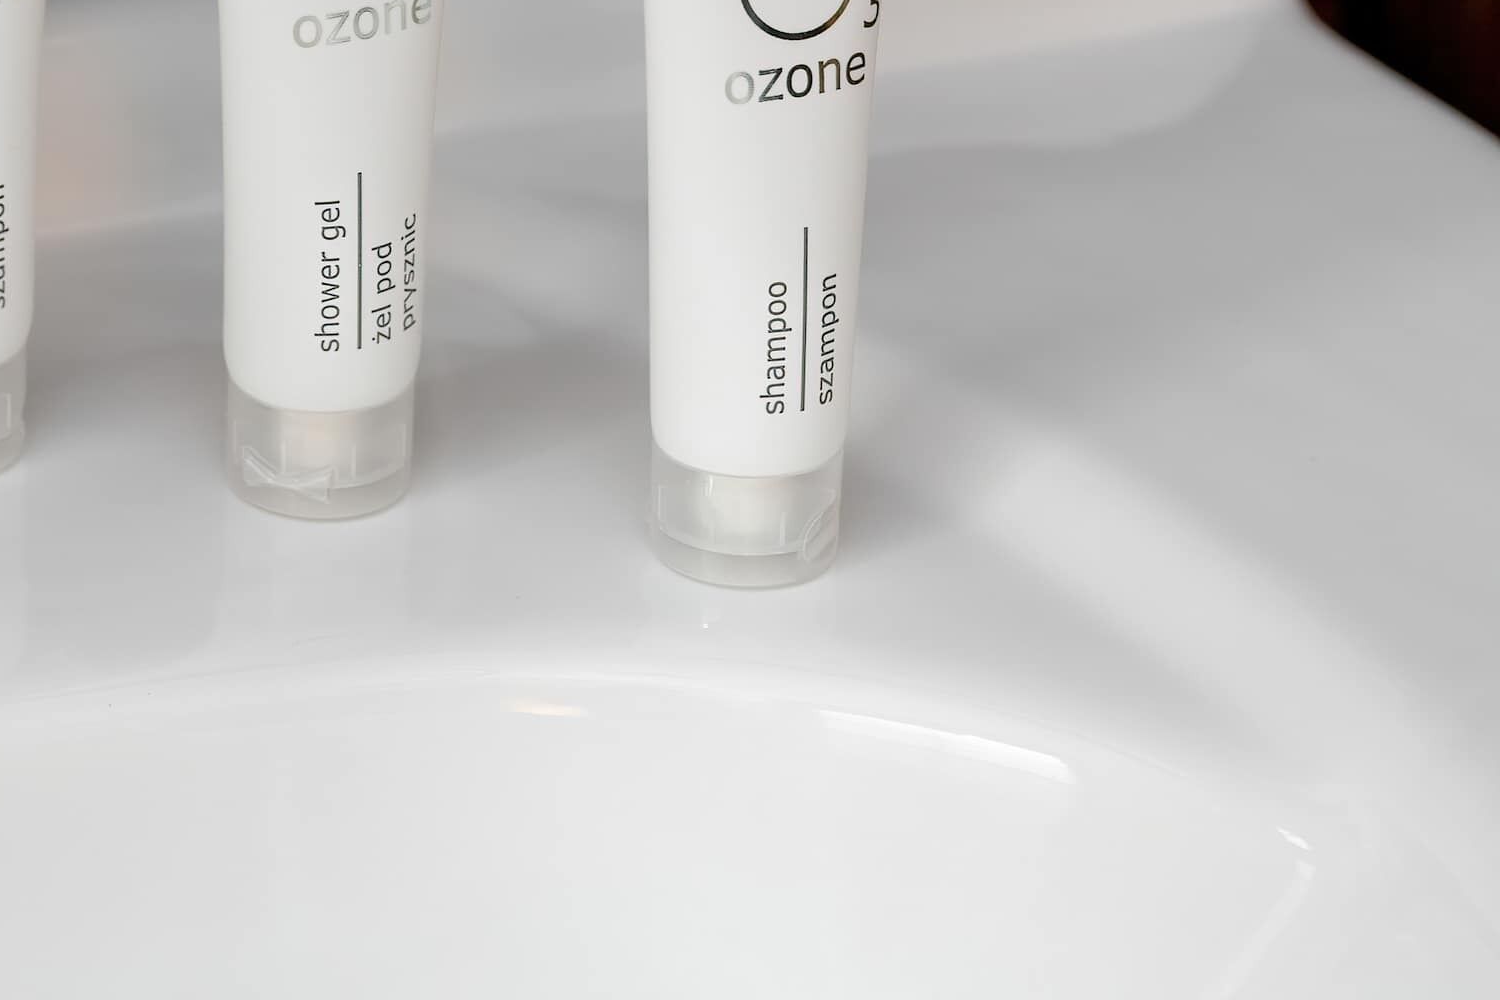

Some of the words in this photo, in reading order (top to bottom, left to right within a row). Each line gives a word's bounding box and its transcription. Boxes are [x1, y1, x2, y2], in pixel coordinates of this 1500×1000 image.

[724, 52, 866, 105] ozone
[314, 200, 346, 241] gel
[314, 251, 340, 352] shower
[371, 241, 396, 292] pod
[400, 212, 417, 332] prysznic
[371, 303, 392, 344] żel
[759, 281, 792, 414] shampoo
[818, 273, 840, 405] szampon
